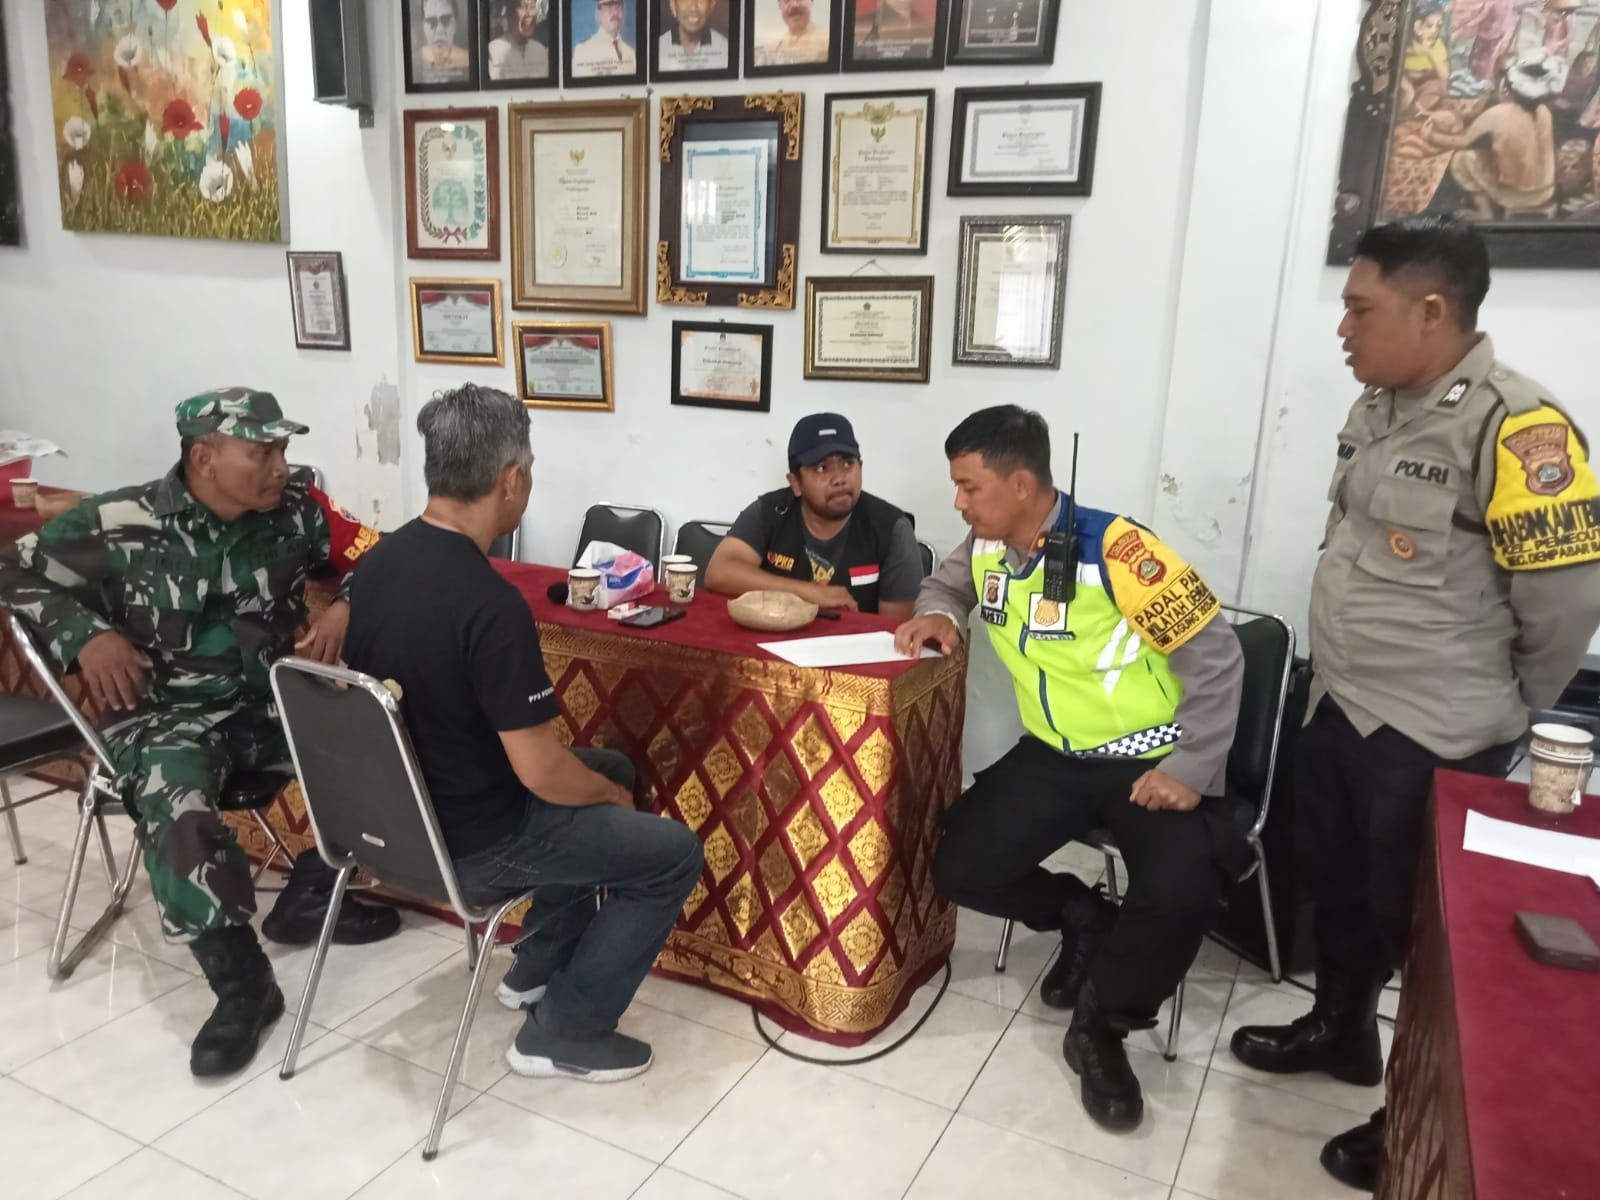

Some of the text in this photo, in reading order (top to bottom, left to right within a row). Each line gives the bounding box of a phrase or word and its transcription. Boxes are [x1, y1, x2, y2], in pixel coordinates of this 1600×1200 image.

[1394, 460, 1449, 485] POLRI
[1134, 590, 1183, 628] PADAL
[1147, 601, 1190, 638] WILAYAH
[1173, 613, 1200, 638] AGUNG
